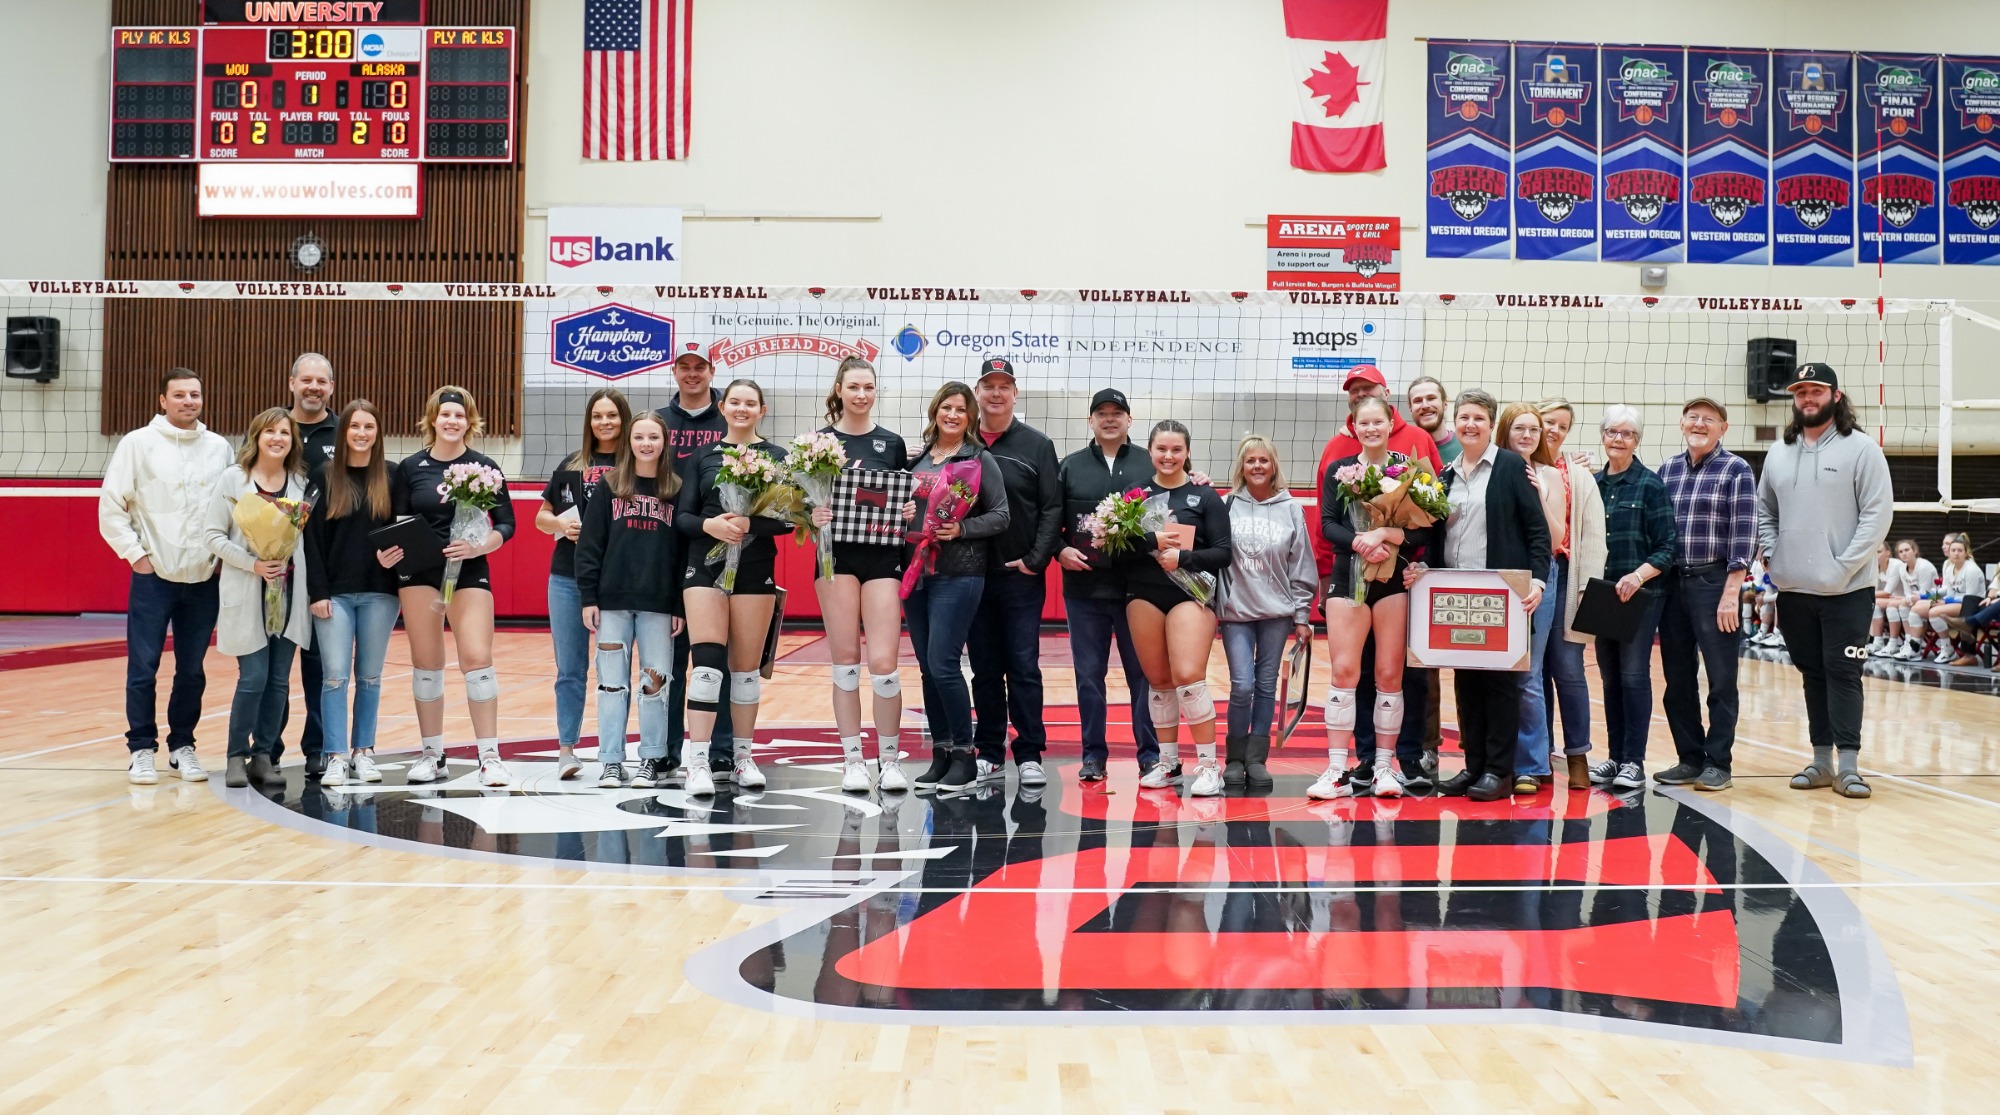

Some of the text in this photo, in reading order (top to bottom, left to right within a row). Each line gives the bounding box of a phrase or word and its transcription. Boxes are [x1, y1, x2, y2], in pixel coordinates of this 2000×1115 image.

[245, 1, 383, 22] UNIVERSITY
[121, 31, 191, 45] PLY AC KLS
[291, 30, 352, 58] 3:00
[433, 31, 504, 45] PLY AC KLS
[225, 63, 249, 76] WOU
[361, 63, 406, 76] ALASKA
[1451, 62, 1485, 76] gnac
[1624, 67, 1659, 80] gnac
[295, 71, 327, 81] PERIOD
[1709, 70, 1743, 83] gnac
[1880, 74, 1913, 87] gnac
[1450, 86, 1489, 94] CONFERENCE
[1965, 77, 1999, 90] gnac
[240, 80, 258, 109] 0
[311, 84, 317, 105] 1
[390, 80, 406, 109] 0
[1529, 87, 1584, 99] TOURNAMENT
[1807, 94, 1837, 102] REGIONAL
[1881, 96, 1916, 106] FINAL
[210, 111, 238, 121] FOULS
[249, 111, 271, 121] T.O.L.
[280, 111, 340, 121] PLAYER FOUL
[350, 111, 372, 121] T.O.L.
[381, 111, 410, 121] FOULS
[1882, 107, 1915, 117] FOUR
[220, 122, 234, 144] 0
[252, 121, 267, 144] 2
[352, 121, 367, 144] 2
[391, 122, 406, 144] 0
[210, 149, 238, 158] SCORE
[295, 149, 324, 158] MATCH
[381, 149, 409, 158] SCORE
[205, 181, 413, 199] www.wouwolves.com
[1432, 176, 1506, 199] OREGON
[1519, 179, 1592, 200] OREGON
[1606, 181, 1679, 202] OREGON
[1692, 184, 1764, 205] OREGON
[1777, 186, 1848, 207] OREGON
[1279, 223, 1346, 236] ARENA
[1346, 223, 1390, 231] SPORTS BAR
[1431, 226, 1507, 236] WESTERN OREGON
[1518, 227, 1594, 238] WESTERN OREGON
[1605, 230, 1681, 240] WESTERN OREGON
[1691, 231, 1765, 242] WESTERN OREGON
[1776, 234, 1850, 244] WESTERN OREGON
[1863, 232, 1936, 243] WESTERN OREGON
[1949, 234, 1987, 244] WESTERN
[1276, 250, 1299, 258] Arena
[1308, 251, 1331, 260] proud
[1287, 261, 1315, 269] support
[1321, 281, 1344, 289] Burgers
[28, 281, 1802, 311] VOLLEYBALL VOLLEYBALL VOLLEYBALL VOLLEYBALL VOLLEYBALL VOLLEYBALL VOLLEYBALL VOLLEYBALL VOLLEYBALL
[708, 315, 881, 329] The Genuine. The Original.
[568, 325, 651, 346] Hampton
[936, 330, 1059, 352] Oregon State
[1292, 331, 1358, 351] maps
[727, 338, 859, 363] OVERHEAD DOO
[1066, 340, 1243, 353] INDEPENDENCE
[565, 345, 607, 364] Inn
[616, 345, 663, 362] Suites
[1023, 352, 1059, 363] Union
[667, 429, 722, 446] ESTERN
[612, 494, 674, 527] WESTERN
[627, 519, 658, 530] WOLVES
[1240, 558, 1264, 570] MOM
